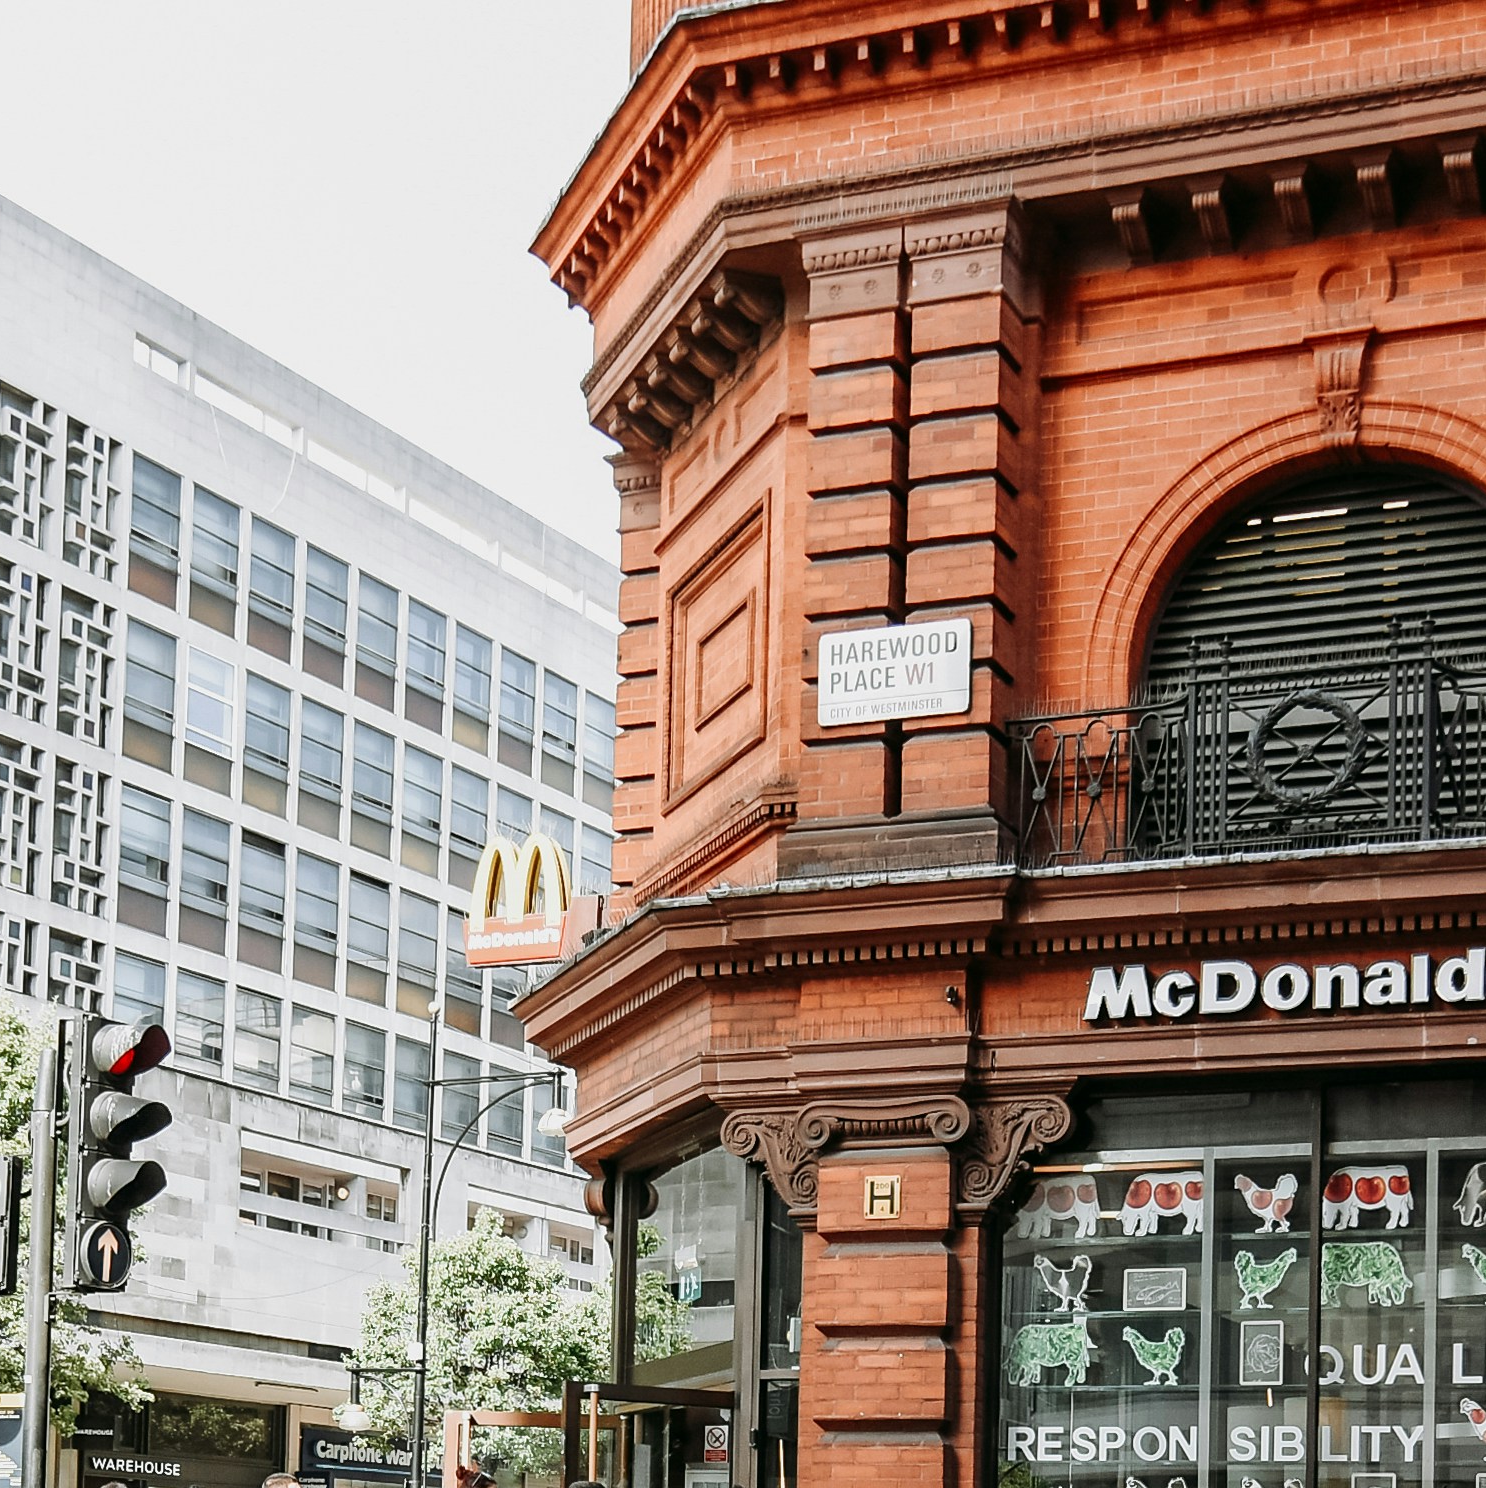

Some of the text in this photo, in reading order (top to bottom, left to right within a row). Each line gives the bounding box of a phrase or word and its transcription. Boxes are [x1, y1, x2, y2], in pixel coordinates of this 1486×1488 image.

[831, 631, 958, 666] HAREWOOD
[831, 661, 934, 694] PLACE W1
[830, 697, 943, 719] CITY OF WESTMINSTER
[467, 926, 561, 950] McDonald's
[869, 1180, 895, 1215] H
[316, 1440, 383, 1463] Carphone
[92, 1457, 181, 1477] WAREHOUSE
